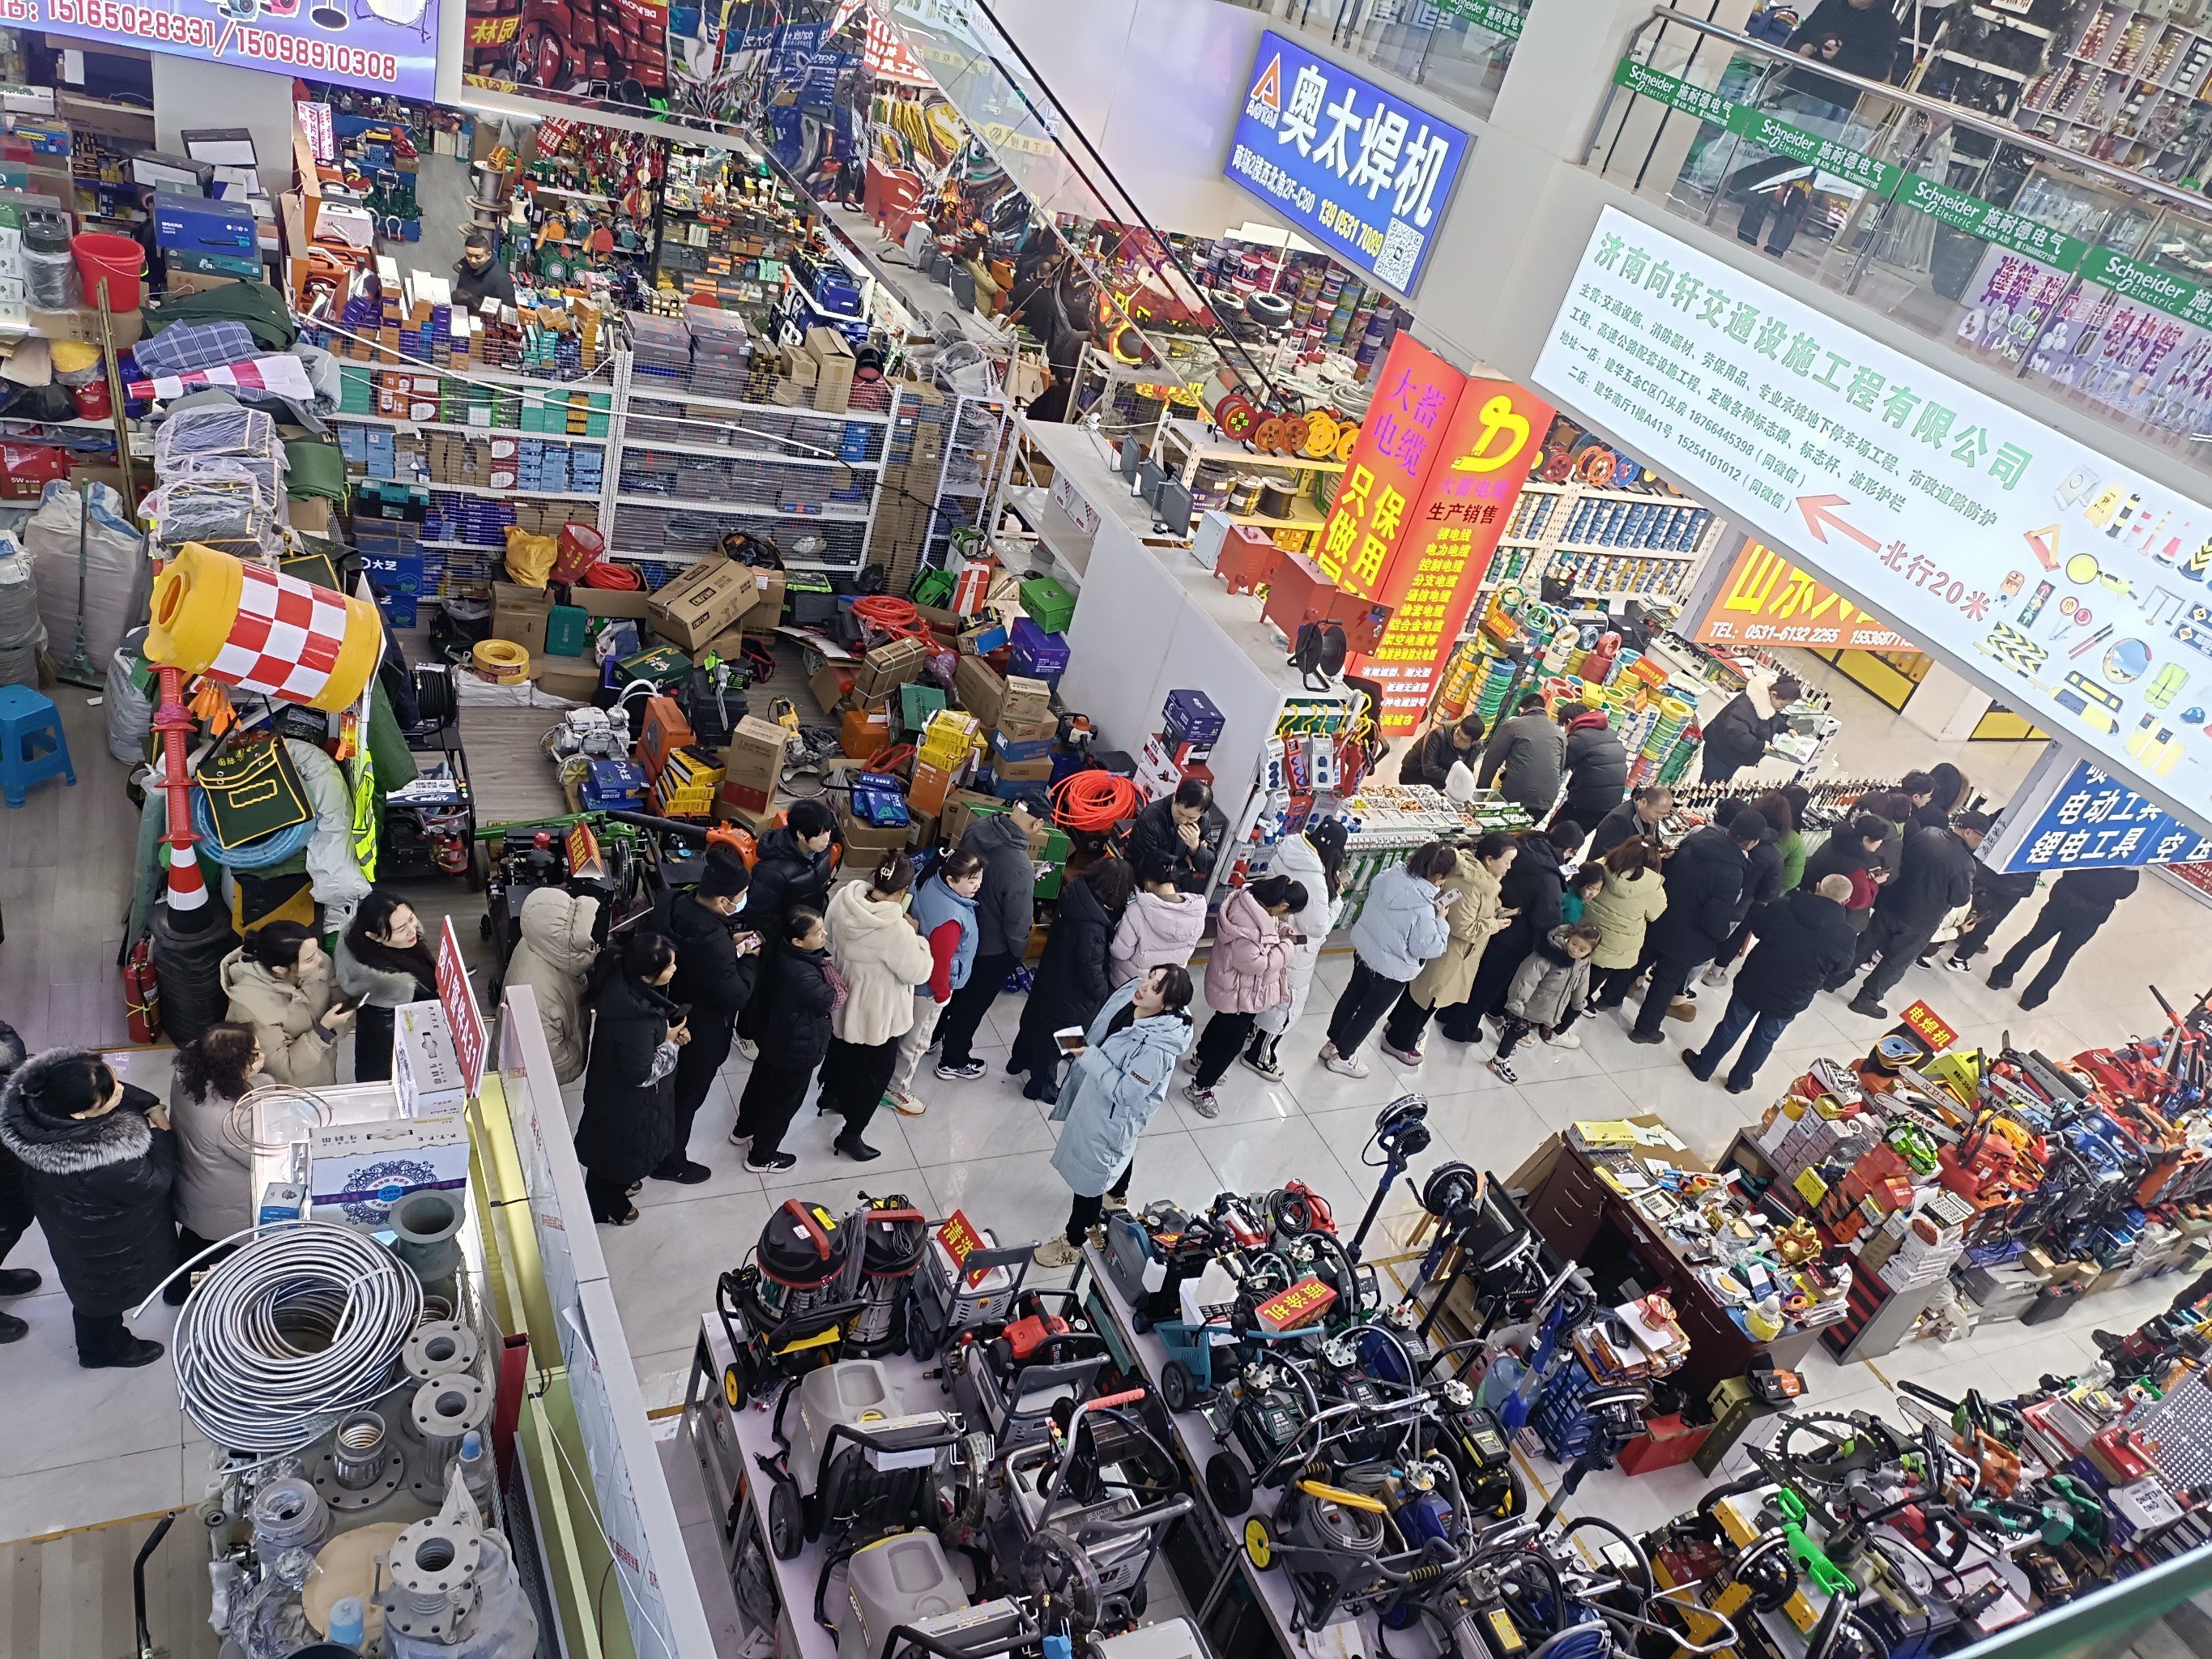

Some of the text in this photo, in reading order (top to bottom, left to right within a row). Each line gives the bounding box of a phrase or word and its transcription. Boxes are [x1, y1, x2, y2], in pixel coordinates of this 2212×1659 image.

[1629, 65, 1733, 119] Schneider 施耐德电气
[1643, 85, 1669, 102] Electric
[1278, 65, 1450, 228] 奥太焊机
[1761, 119, 1815, 151] Schneider
[1817, 141, 1886, 181] 施耐德电气
[1778, 141, 1809, 160] Electric
[1914, 181, 2066, 255] Schneider 施耐德电气
[1935, 205, 1971, 228] Electric
[2106, 256, 2185, 299] Schneider
[2130, 284, 2176, 310] Electric
[1594, 232, 2033, 490] 济南向轩交通设施工程有限公司
[1374, 413, 1427, 477] 电缆
[1426, 501, 1498, 525] 生产销售
[1426, 542, 1473, 557] 电力电缆
[1412, 573, 1459, 588] 分支电缆
[1880, 540, 1993, 623] 北行20米
[1809, 628, 1840, 642] 2255
[2027, 827, 2146, 864] 锂电工具
[1908, 1006, 1951, 1048] 电焊机
[2015, 1090, 2039, 1107] MATT
[1264, 1282, 1328, 1321] 喷涂机
